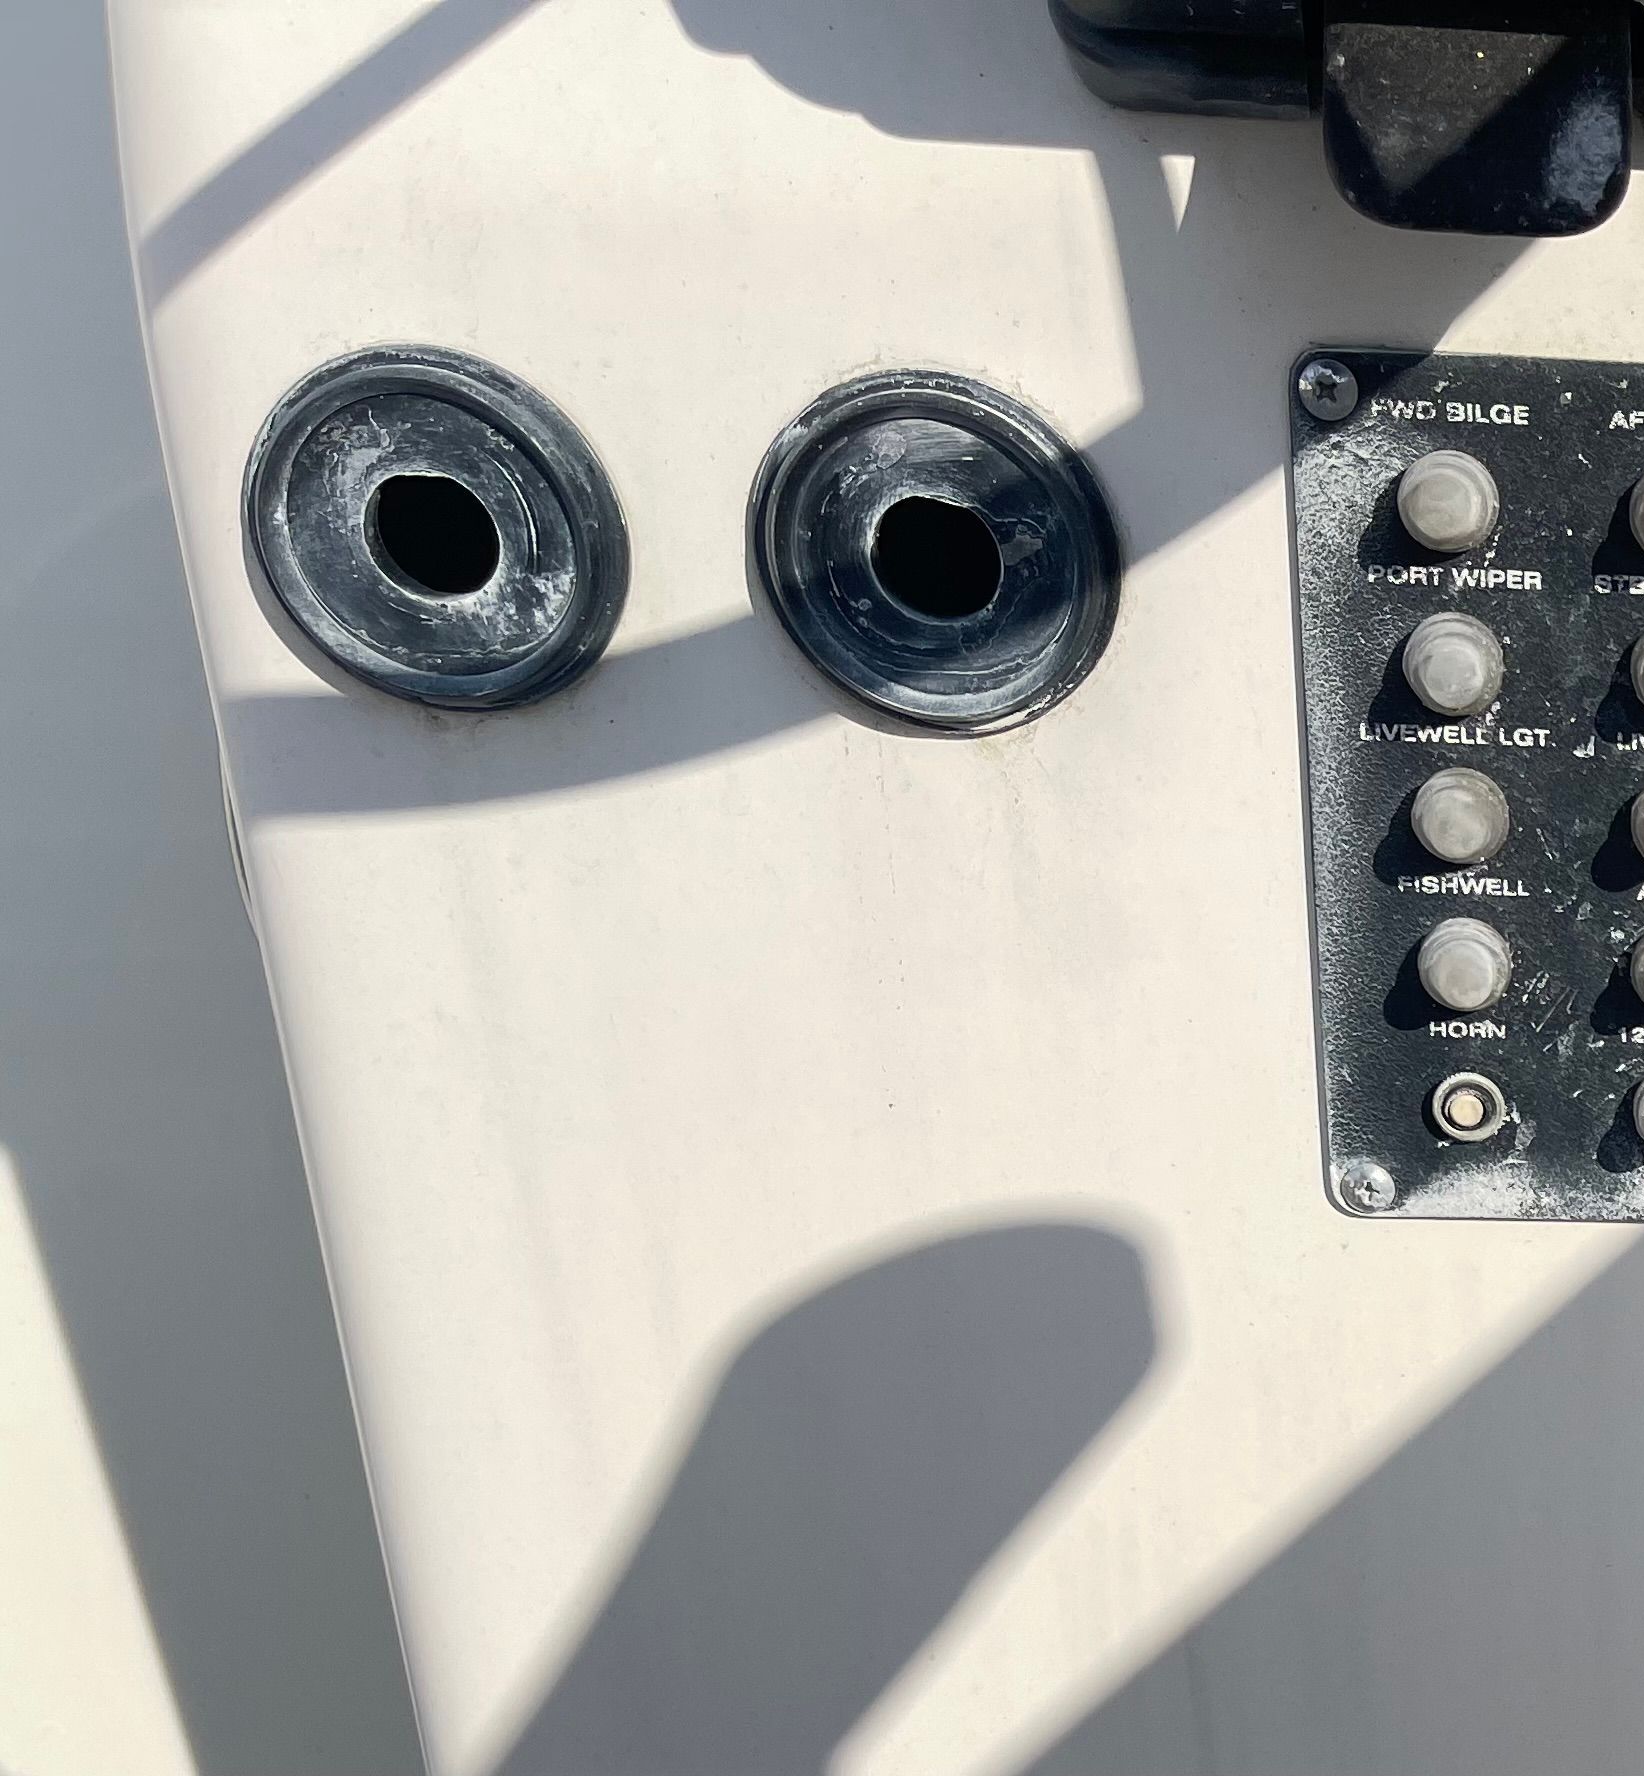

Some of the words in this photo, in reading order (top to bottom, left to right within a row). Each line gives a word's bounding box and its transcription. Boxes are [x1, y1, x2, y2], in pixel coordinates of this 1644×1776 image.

[1370, 398, 1436, 420] FWD
[1446, 401, 1531, 426] BILGE
[1368, 564, 1444, 586] PORT
[1452, 567, 1543, 591] WIPER
[1359, 722, 1490, 745] LIVEWELL
[1397, 875, 1530, 897] FISHWELL
[1429, 1019, 1506, 1039] HORN
